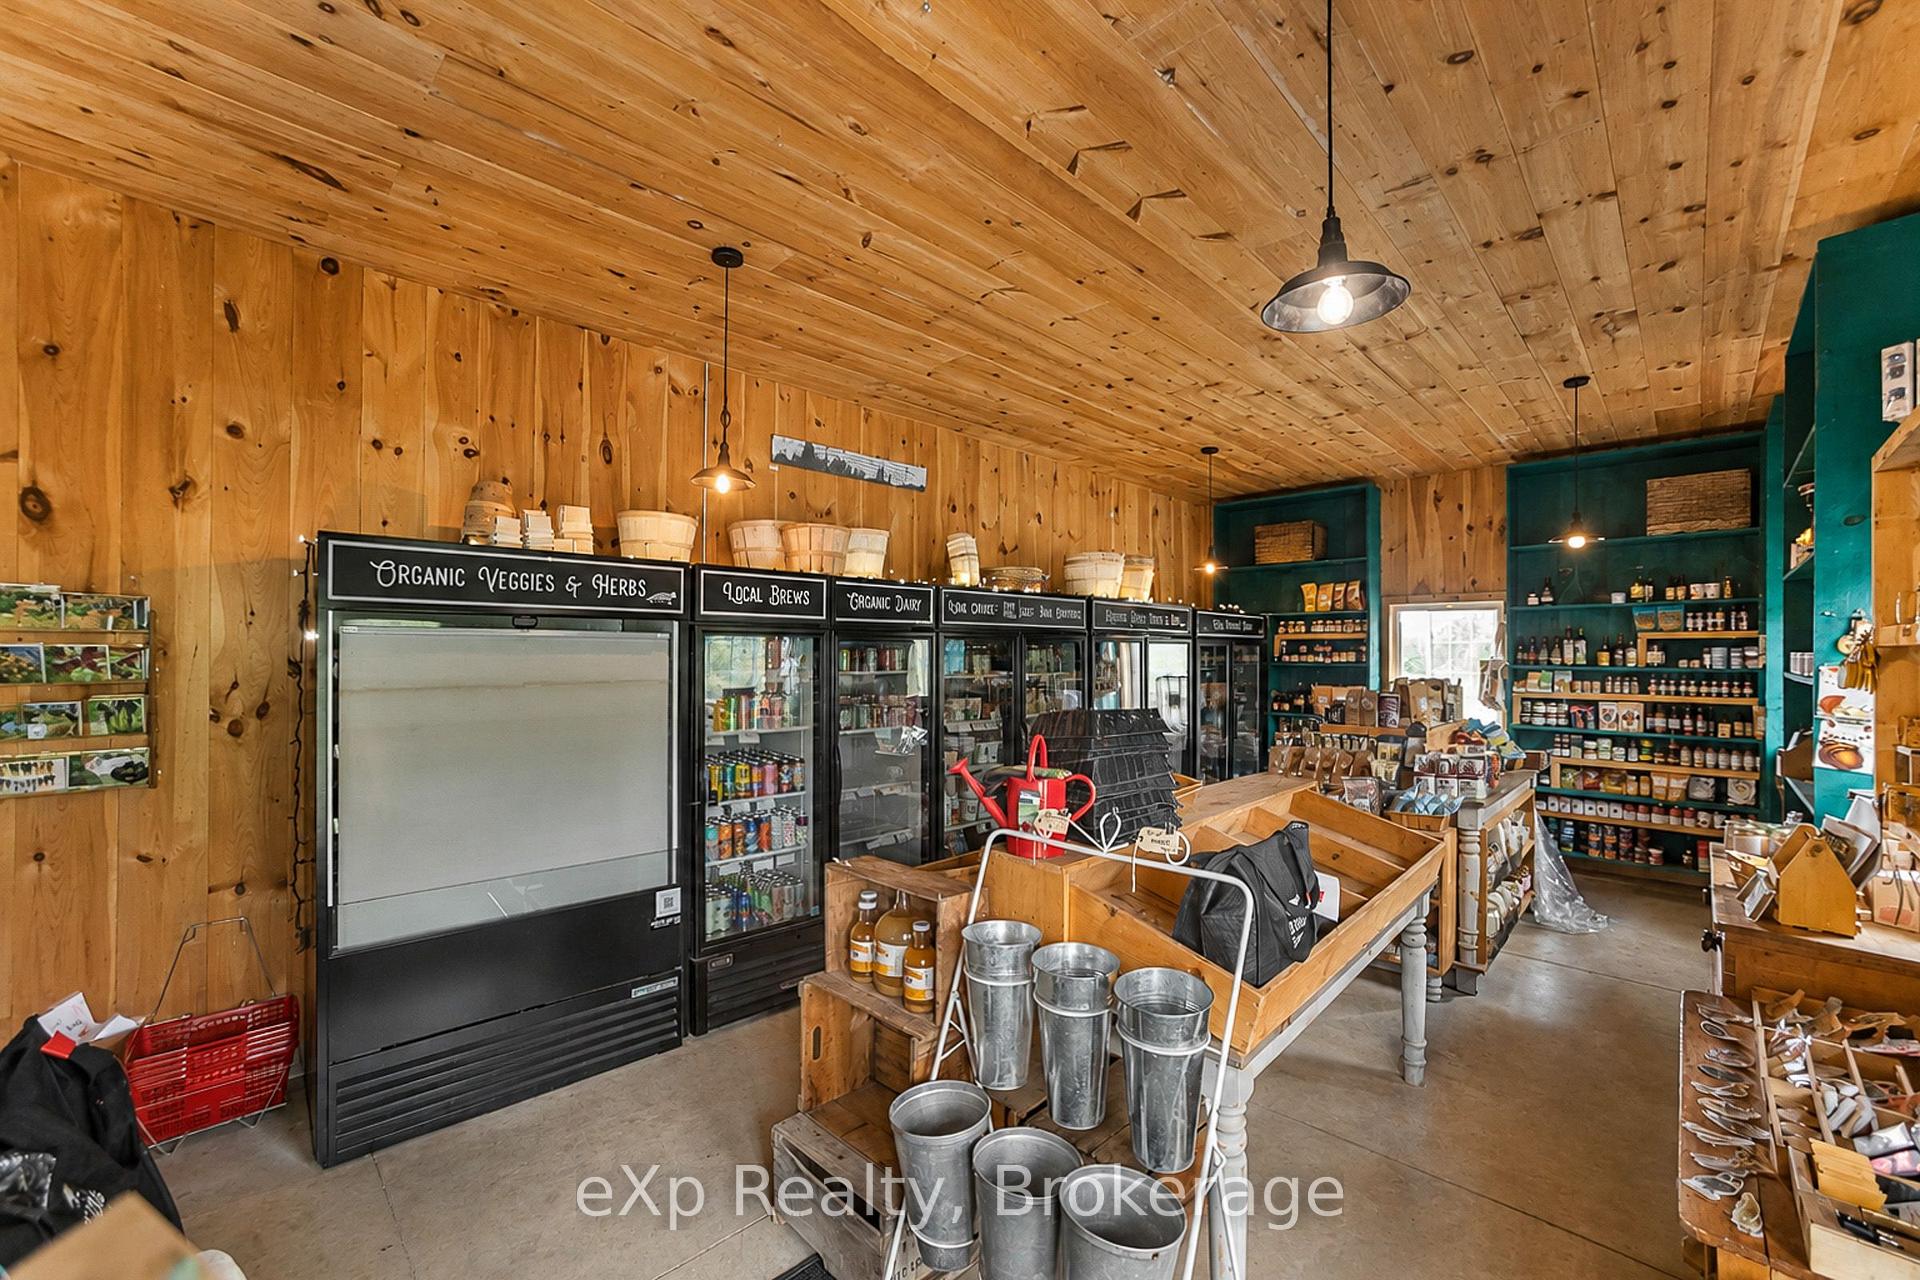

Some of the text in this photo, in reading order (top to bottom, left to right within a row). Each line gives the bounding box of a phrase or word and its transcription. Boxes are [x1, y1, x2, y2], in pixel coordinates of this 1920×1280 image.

[369, 560, 647, 598] ORGANIC VEGGIES & HERBS
[722, 582, 810, 606] LOCAL BREWS
